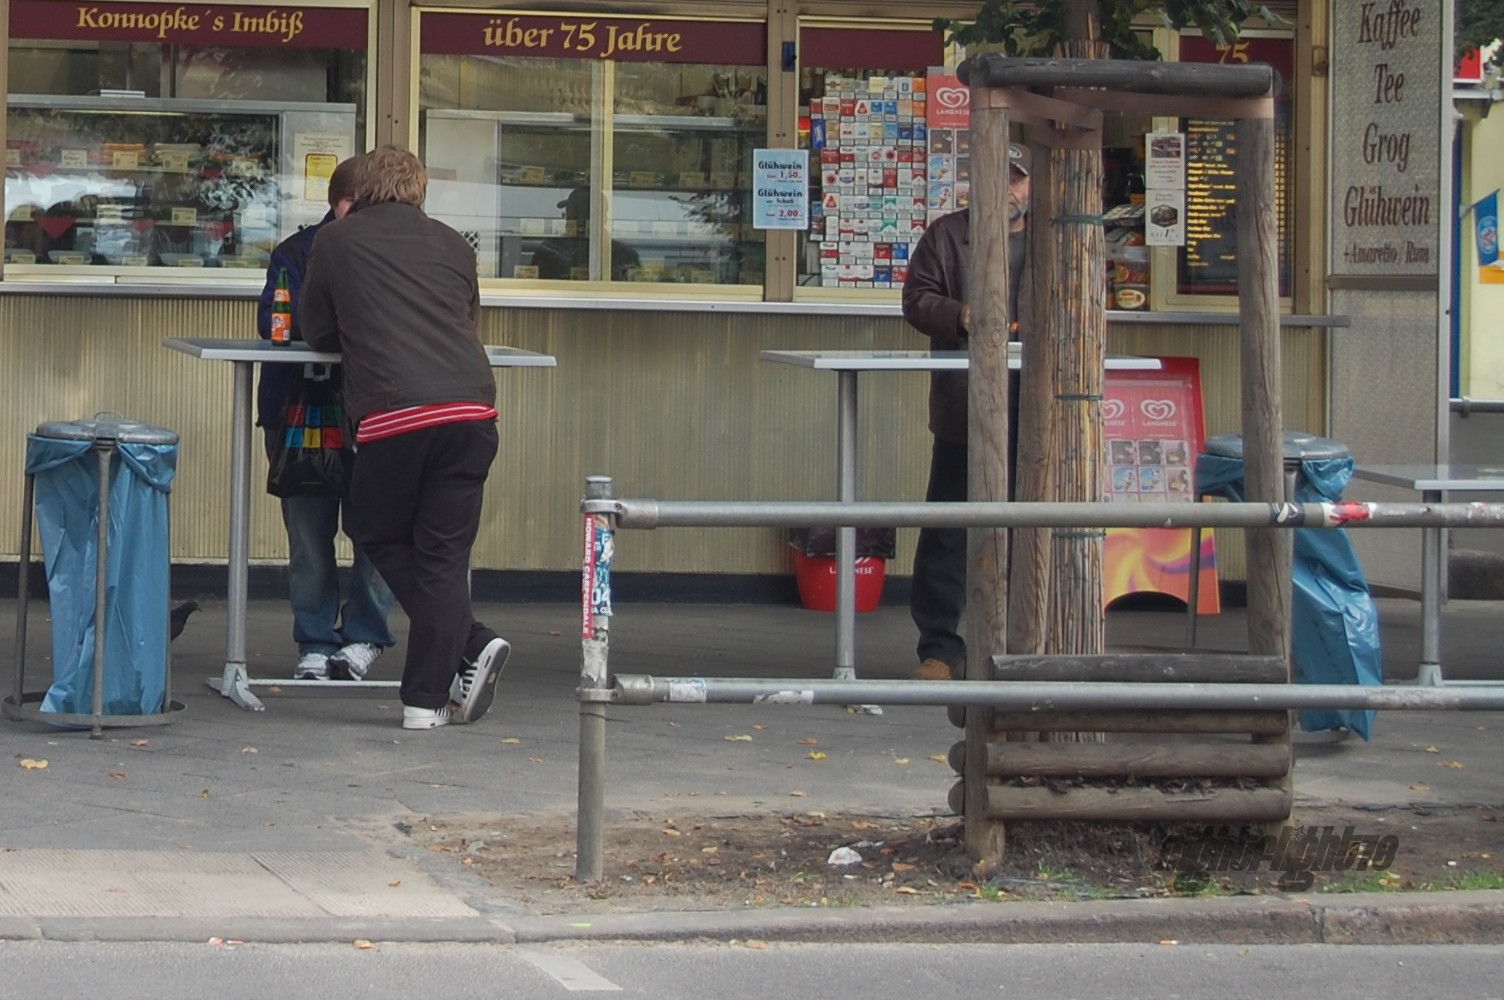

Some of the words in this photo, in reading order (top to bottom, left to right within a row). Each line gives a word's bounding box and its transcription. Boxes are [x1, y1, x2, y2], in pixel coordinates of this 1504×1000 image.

[231, 11, 304, 44] Imbiß
[483, 17, 554, 48] über
[560, 21, 597, 51] 75
[600, 23, 683, 58] Jahre
[1214, 40, 1250, 63] 75
[1373, 63, 1405, 104] Tee
[1362, 122, 1411, 174] Grog
[1344, 184, 1430, 228] Glühwein
